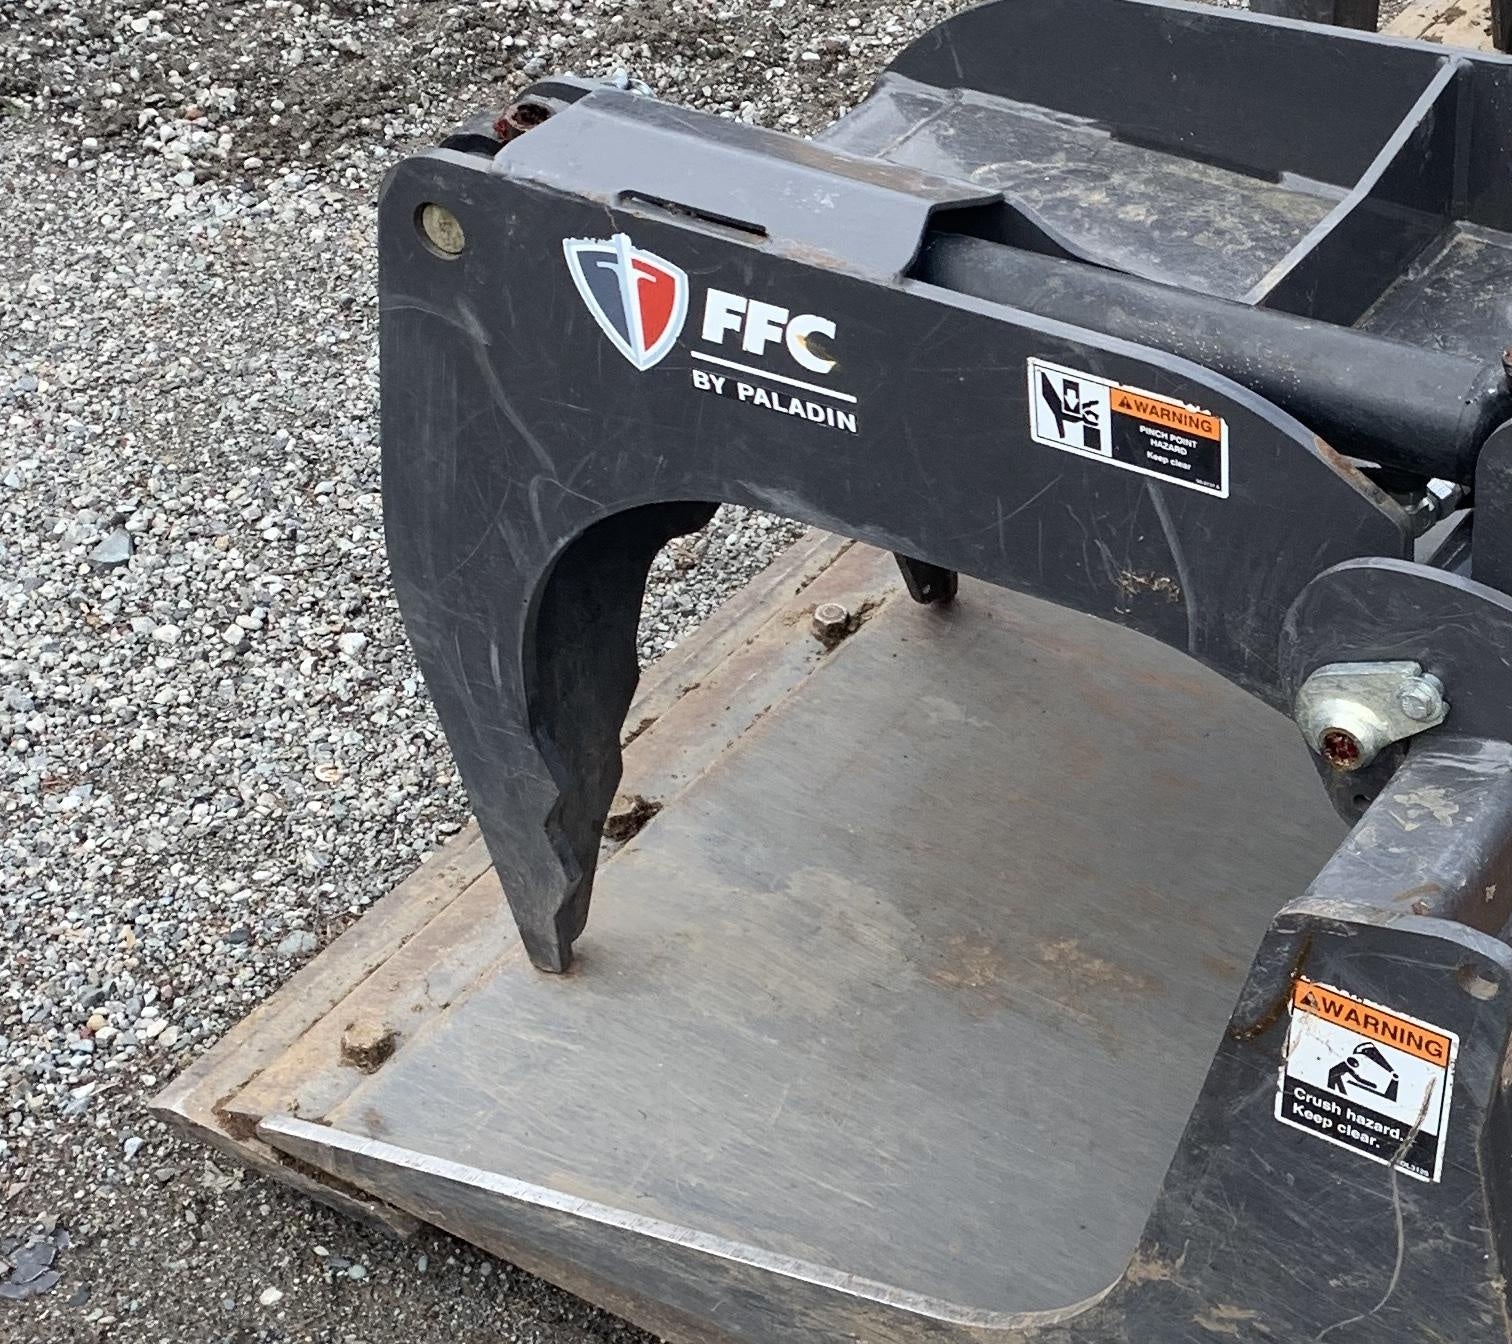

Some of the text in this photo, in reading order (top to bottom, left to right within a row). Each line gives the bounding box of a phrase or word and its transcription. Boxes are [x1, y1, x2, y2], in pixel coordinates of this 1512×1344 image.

[701, 287, 838, 374] FFC
[692, 369, 858, 434] BY PALADIN
[1134, 398, 1213, 433] WARNING
[1139, 425, 1198, 449] PINCH POINT
[1150, 438, 1188, 456] HAZARD
[1146, 450, 1192, 471] Keep clear
[1321, 996, 1444, 1058] WARNING
[1292, 1103, 1381, 1149] Keep clear.
[1293, 1087, 1405, 1142] Crush hazard.
